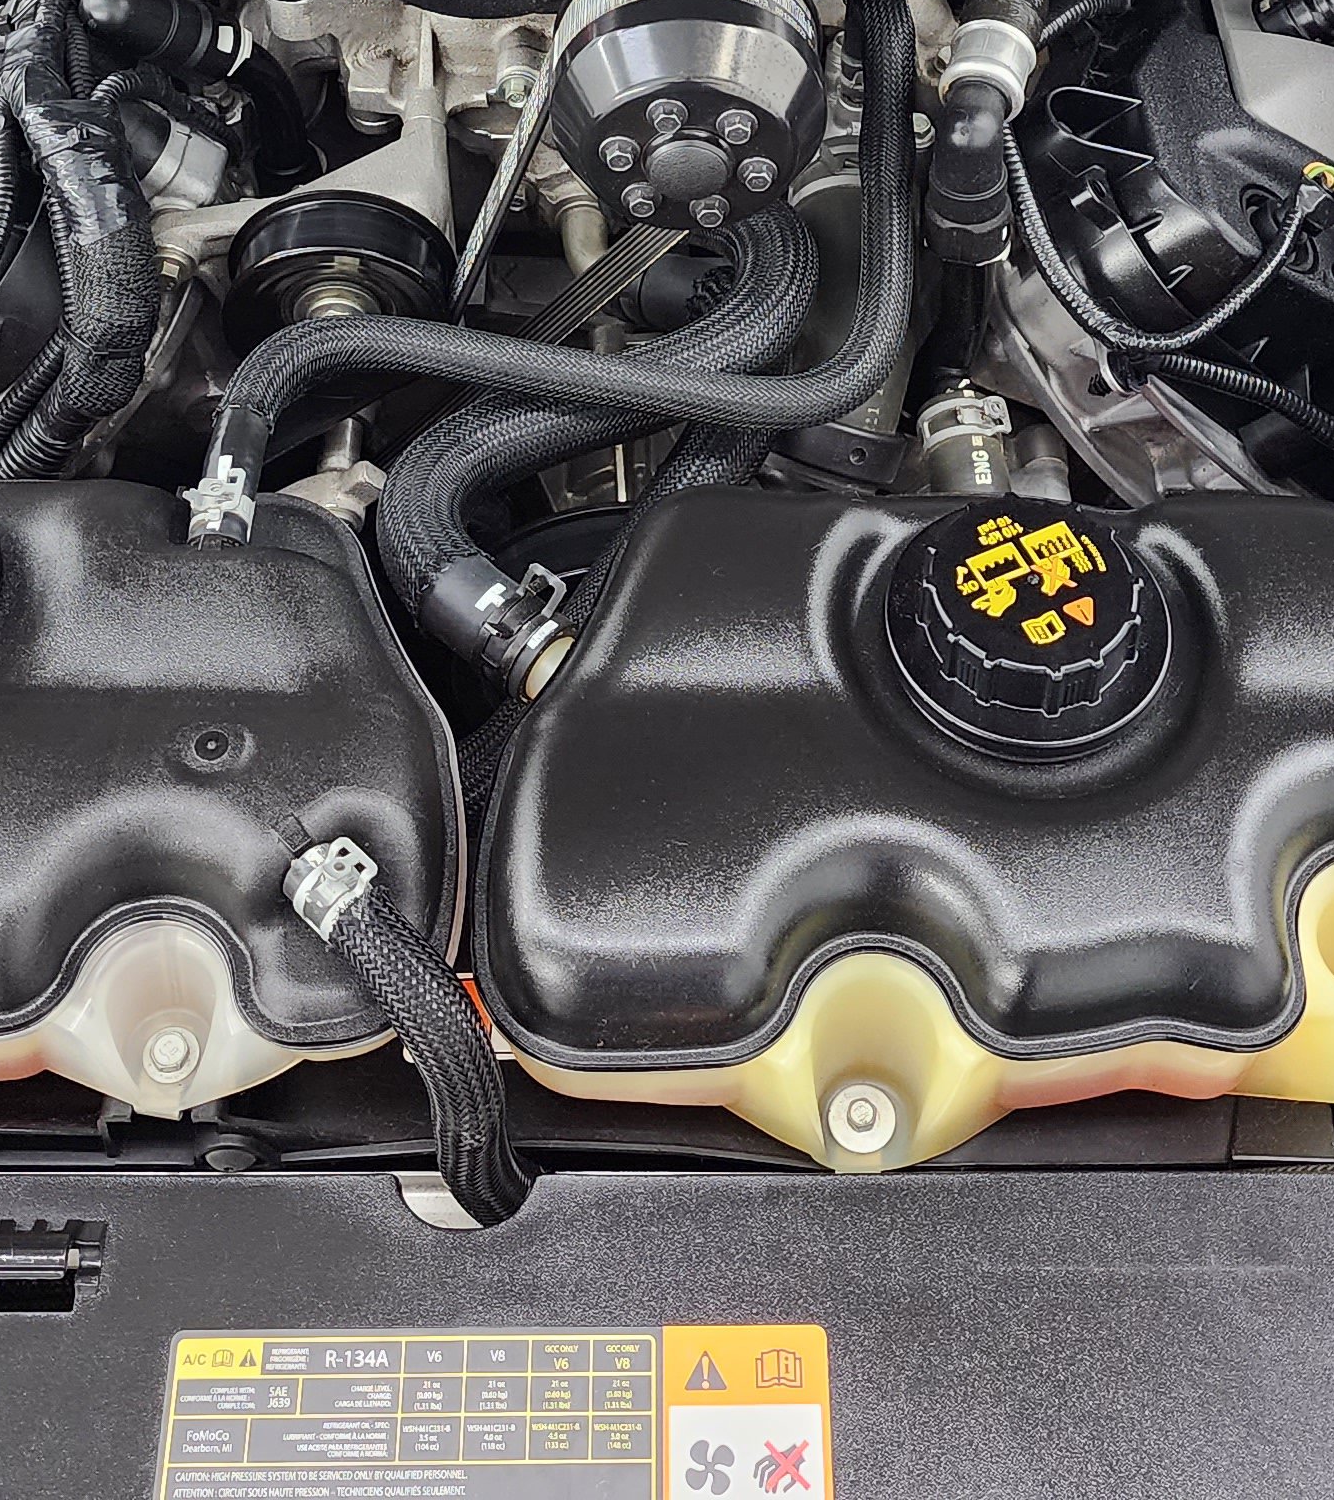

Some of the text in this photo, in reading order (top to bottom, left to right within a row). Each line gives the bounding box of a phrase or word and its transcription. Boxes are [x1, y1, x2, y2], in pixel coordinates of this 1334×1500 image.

[974, 449, 992, 486] ENG
[977, 519, 995, 535] psi
[978, 522, 1023, 546] 110 kPa
[957, 579, 980, 595] OK
[183, 1349, 506, 1368] A/C R-134A V6 V8
[545, 1345, 579, 1370] GCC ONLY V6
[606, 1345, 640, 1370] GCC ONLY V8
[423, 1381, 441, 1389] 21 oz
[487, 1381, 506, 1389] 21 oz
[551, 1381, 568, 1389] 21 oz
[612, 1381, 630, 1389] 21 oz
[268, 1386, 288, 1397] SAE
[432, 1391, 443, 1401] kg)
[497, 1391, 508, 1401] kg)
[560, 1391, 571, 1401] kg)
[622, 1391, 633, 1401] kg)
[267, 1398, 291, 1409] J639
[334, 1400, 355, 1408] CARGA
[187, 1430, 230, 1441] FoMoCo
[183, 1444, 232, 1454] Dearborn, MI
[175, 1470, 467, 1482] CAUTION: HIGH PRESSURE SYSTEM TO BE SERVICED ONLY BY QUALIFIED PERSONNEL.
[218, 1488, 247, 1497] CIRCUIT
[247, 1488, 267, 1497] SOUS
[269, 1487, 293, 1497] HAUTE
[295, 1487, 329, 1497] PRESSION
[337, 1487, 384, 1497] TECHNICIENS
[384, 1485, 422, 1496] QUALIFIÉS
[423, 1486, 465, 1496] SEULEMENT.
